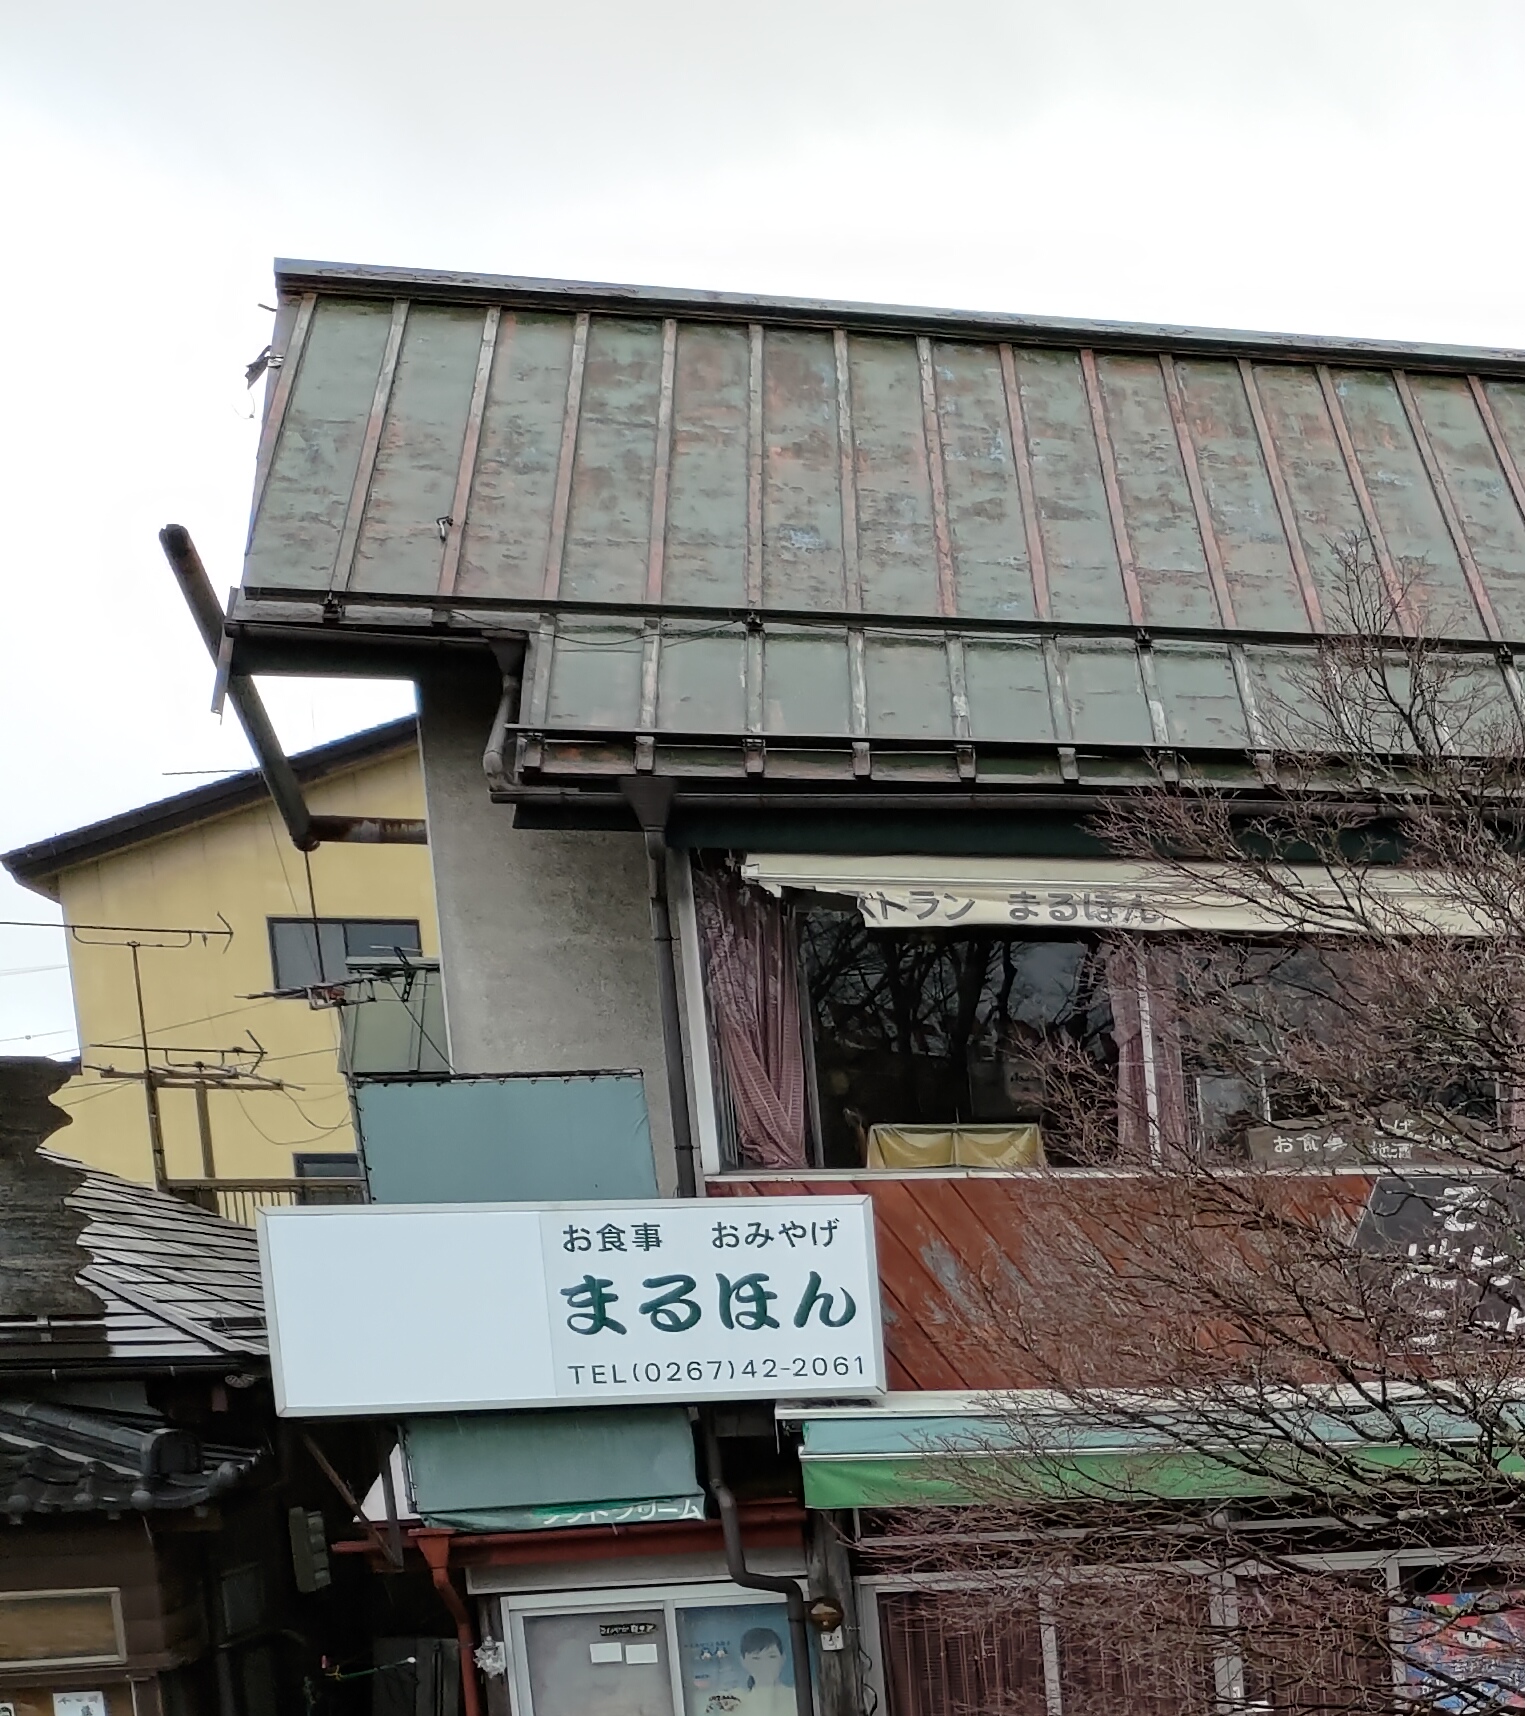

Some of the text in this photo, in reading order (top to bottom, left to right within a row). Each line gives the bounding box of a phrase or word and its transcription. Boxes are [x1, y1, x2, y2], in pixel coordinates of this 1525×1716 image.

[562, 1217, 840, 1252] お食事 おみやげ
[560, 1271, 857, 1336] まるほん
[567, 1355, 866, 1386] TEL(0267)42-2061
